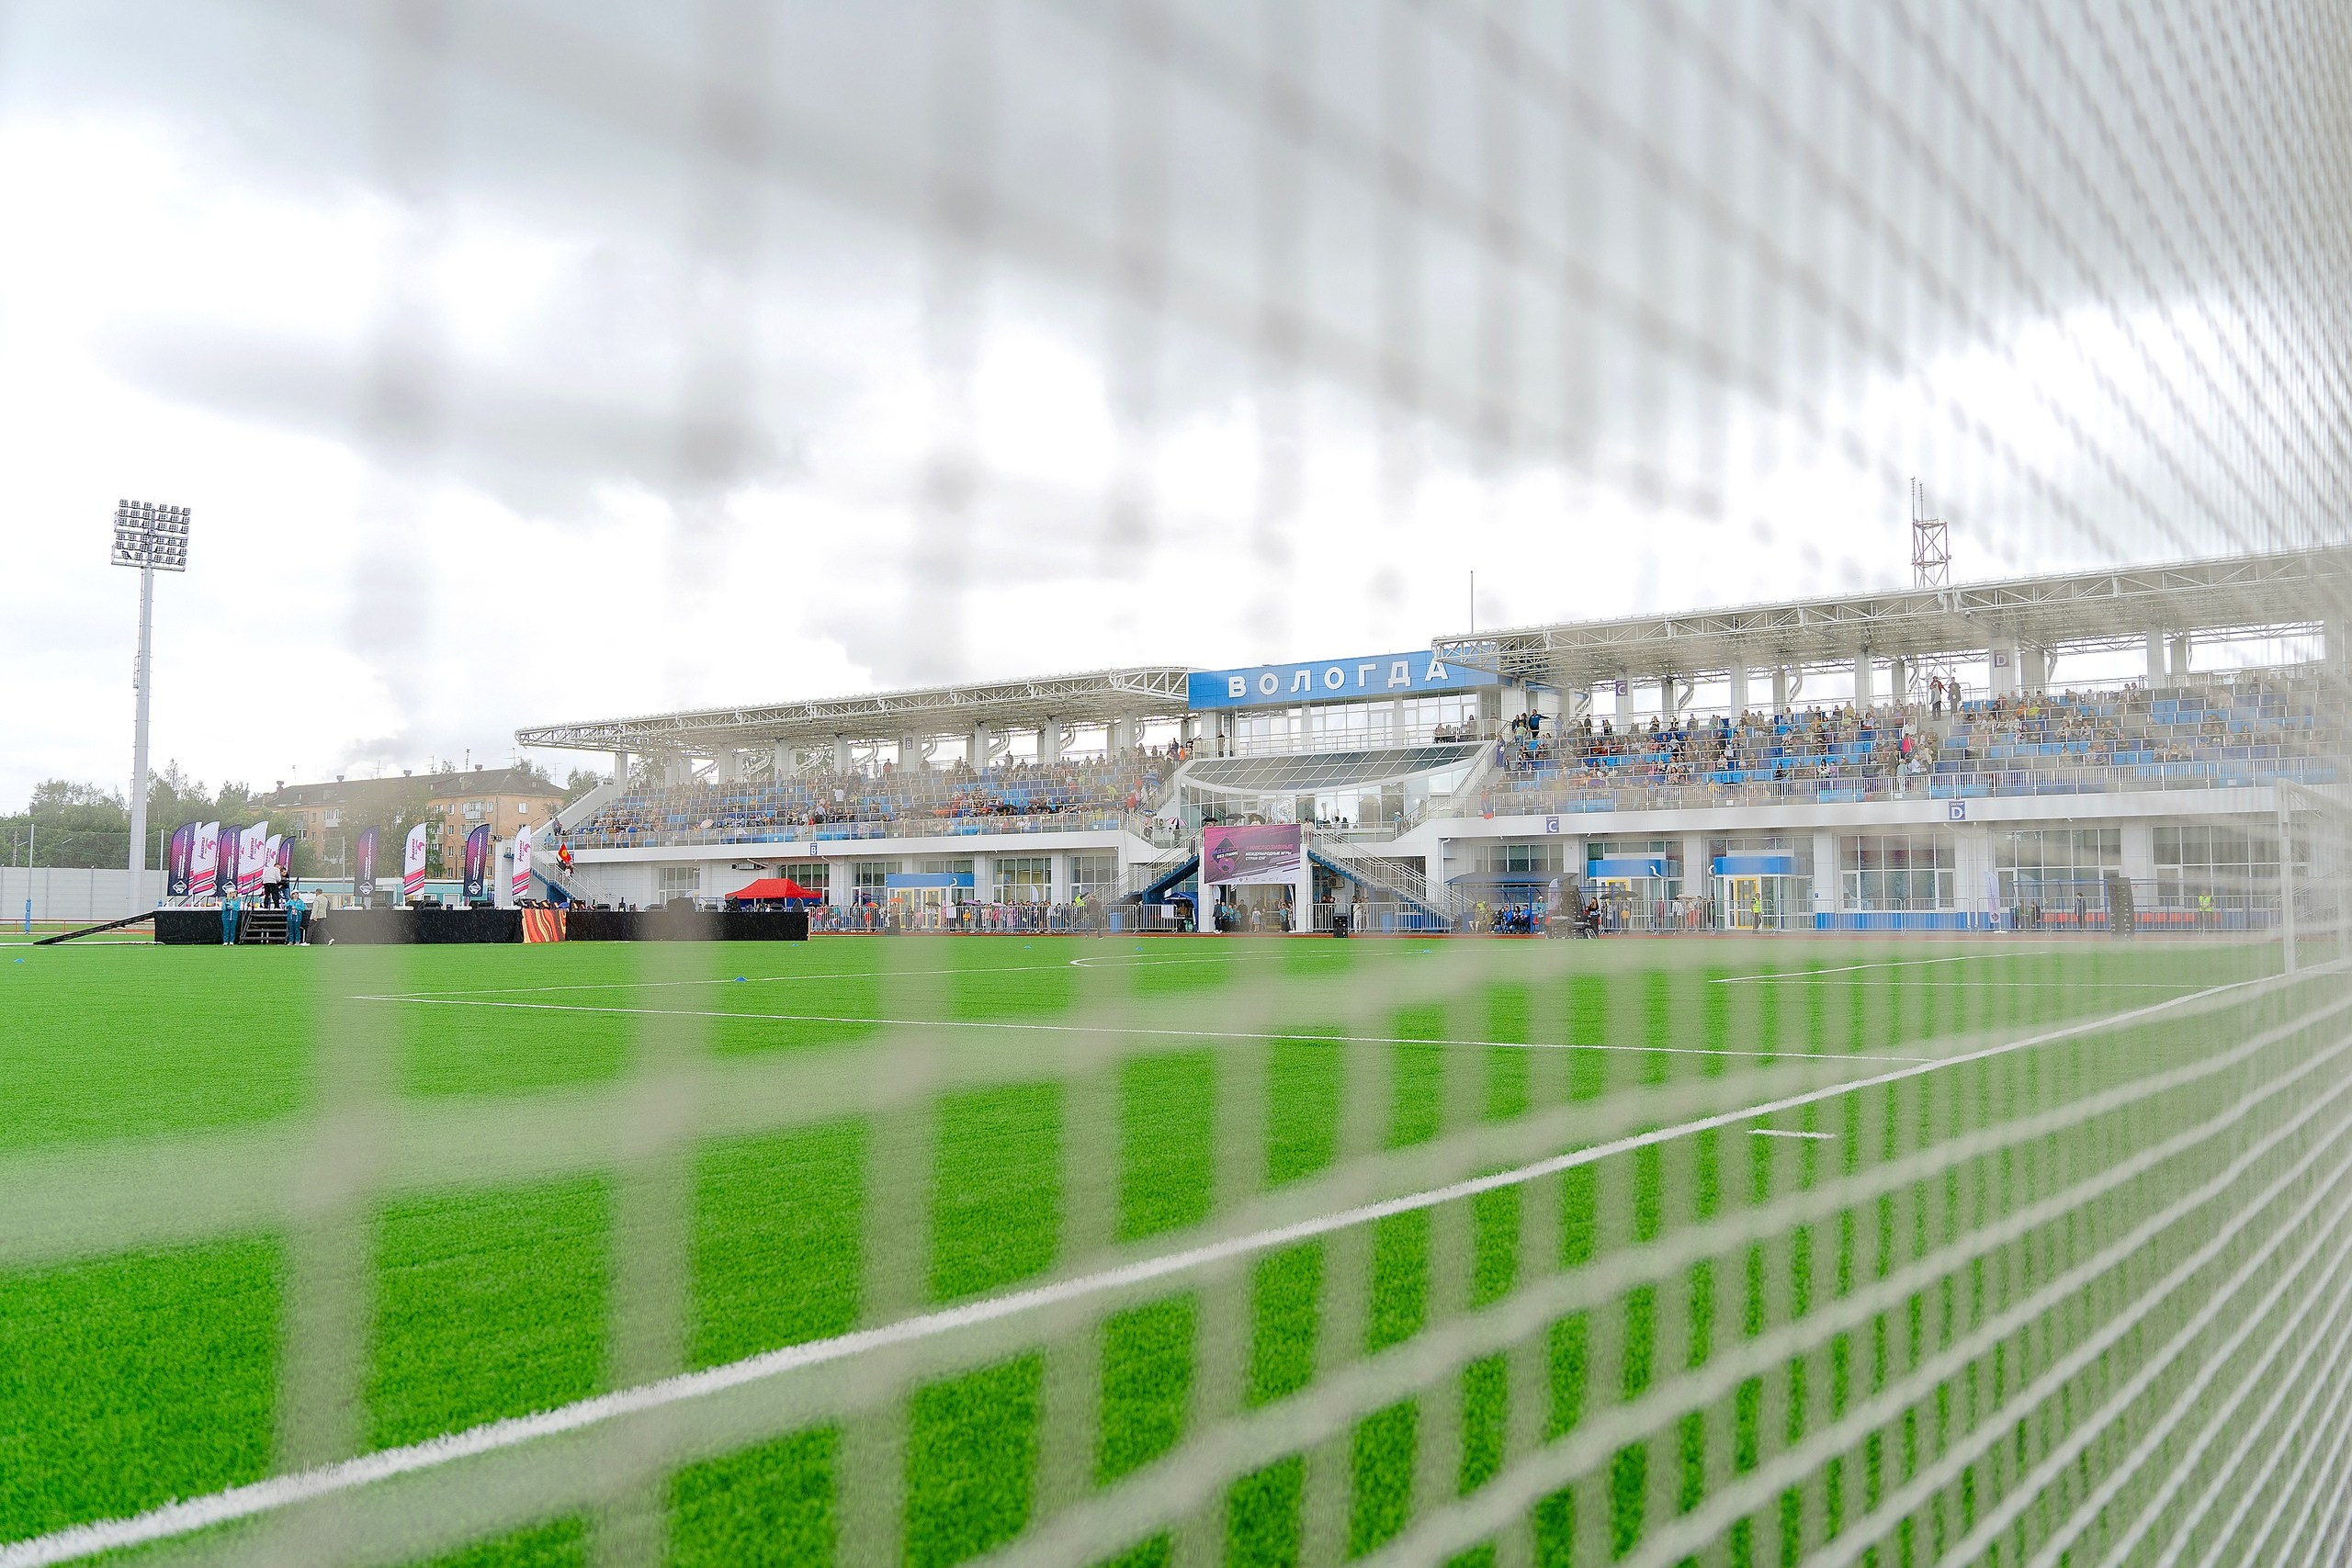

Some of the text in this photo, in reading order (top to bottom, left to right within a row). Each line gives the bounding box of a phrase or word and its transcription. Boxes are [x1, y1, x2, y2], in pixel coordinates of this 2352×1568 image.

[1996, 654, 2007, 666] D
[1228, 659, 1448, 698] ВОЛОГДА
[1617, 684, 1625, 695] C
[1951, 807, 1963, 819] D
[1548, 820, 1557, 832] C
[810, 846, 817, 855] B
